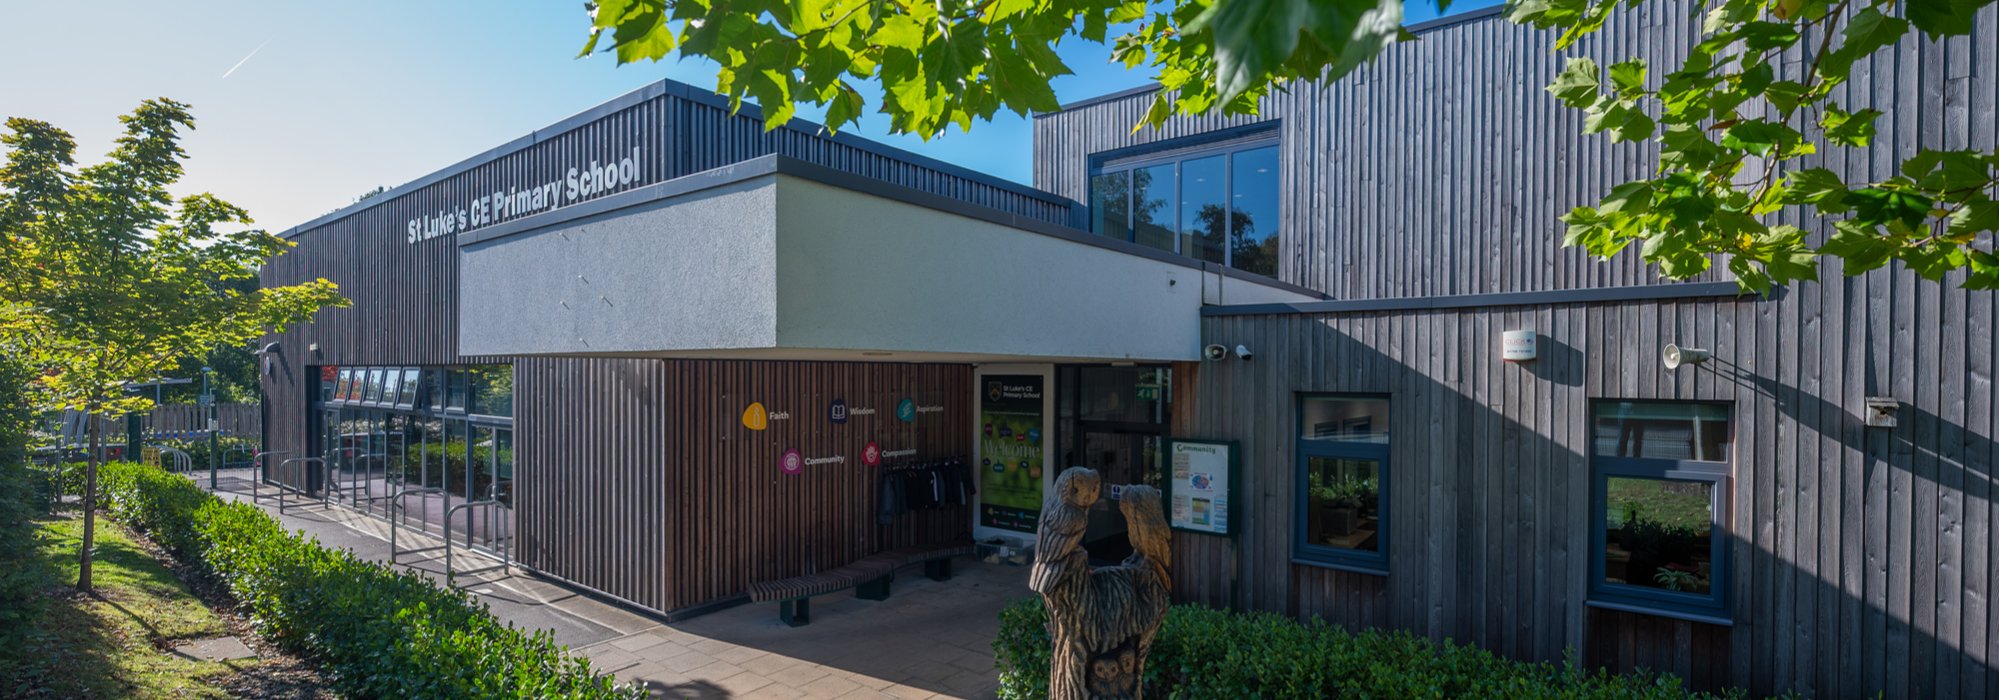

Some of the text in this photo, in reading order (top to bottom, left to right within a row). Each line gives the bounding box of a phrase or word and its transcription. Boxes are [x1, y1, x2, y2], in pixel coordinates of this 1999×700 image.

[408, 146, 640, 244] St Luke's CE Primary School
[849, 406, 875, 416] Wisdom
[915, 404, 944, 414] Aspiration
[769, 410, 790, 420] Faith
[881, 447, 917, 459] Compassion
[984, 439, 1040, 458] Welcome
[1177, 444, 1216, 455] Community
[804, 455, 845, 466] Community
